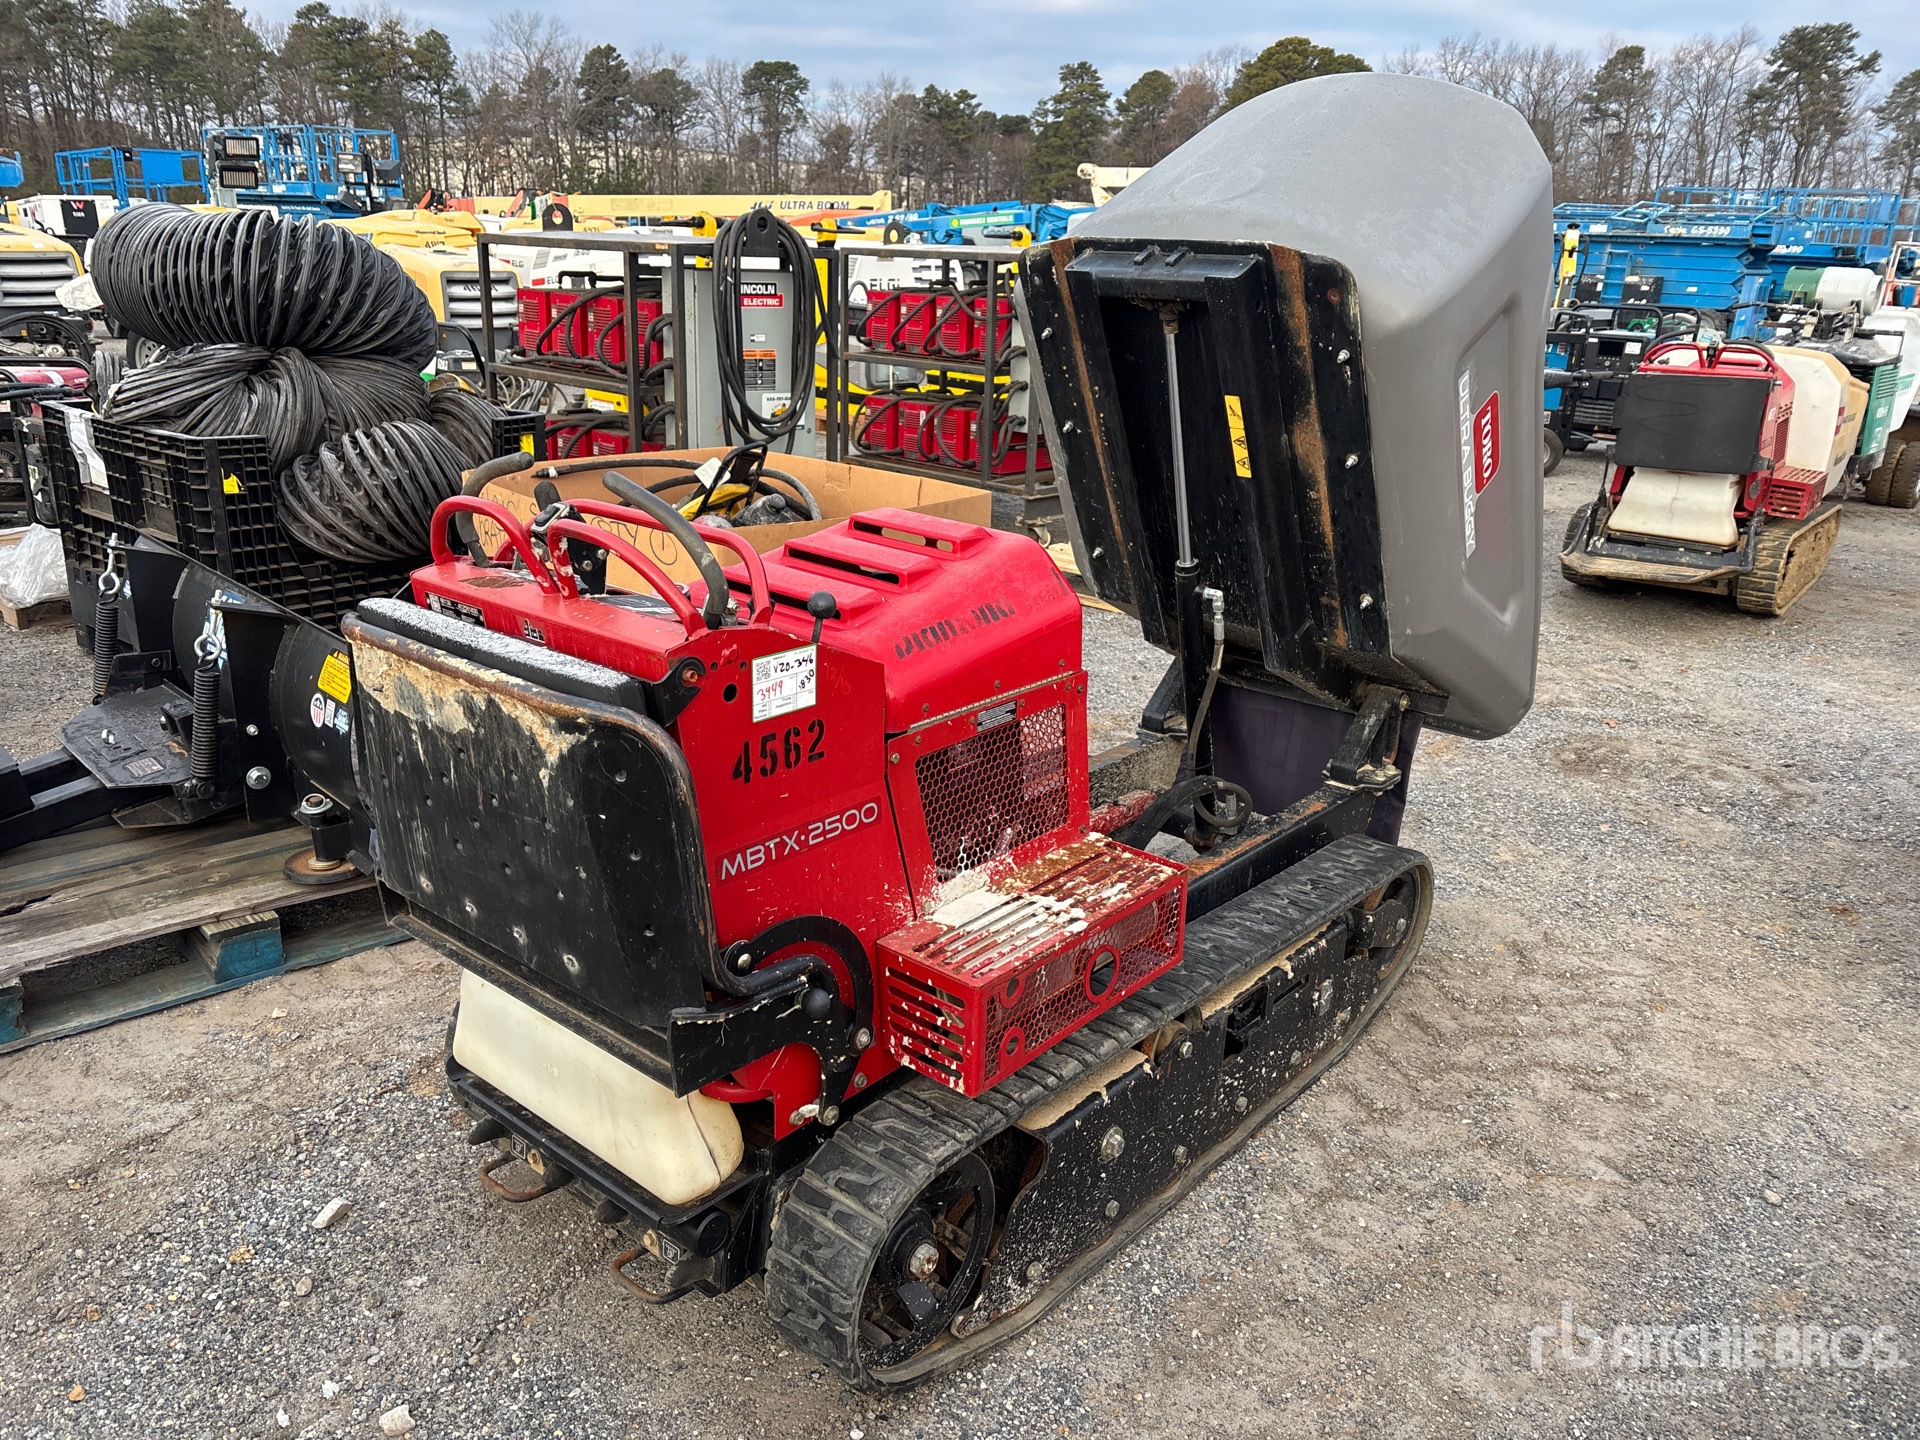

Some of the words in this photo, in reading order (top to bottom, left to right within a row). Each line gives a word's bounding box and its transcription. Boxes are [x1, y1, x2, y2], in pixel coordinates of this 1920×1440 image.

[780, 200, 813, 210] ULTRA
[817, 200, 850, 210] BOOM
[1690, 225, 1731, 236] GS-5390
[740, 283, 775, 295] INCOLN
[743, 297, 780, 306] ELECTRIC
[1459, 375, 1471, 461] ULTRA
[1481, 405, 1493, 480] TORO
[1462, 470, 1476, 548] BUGGY
[732, 719, 826, 784] 4562
